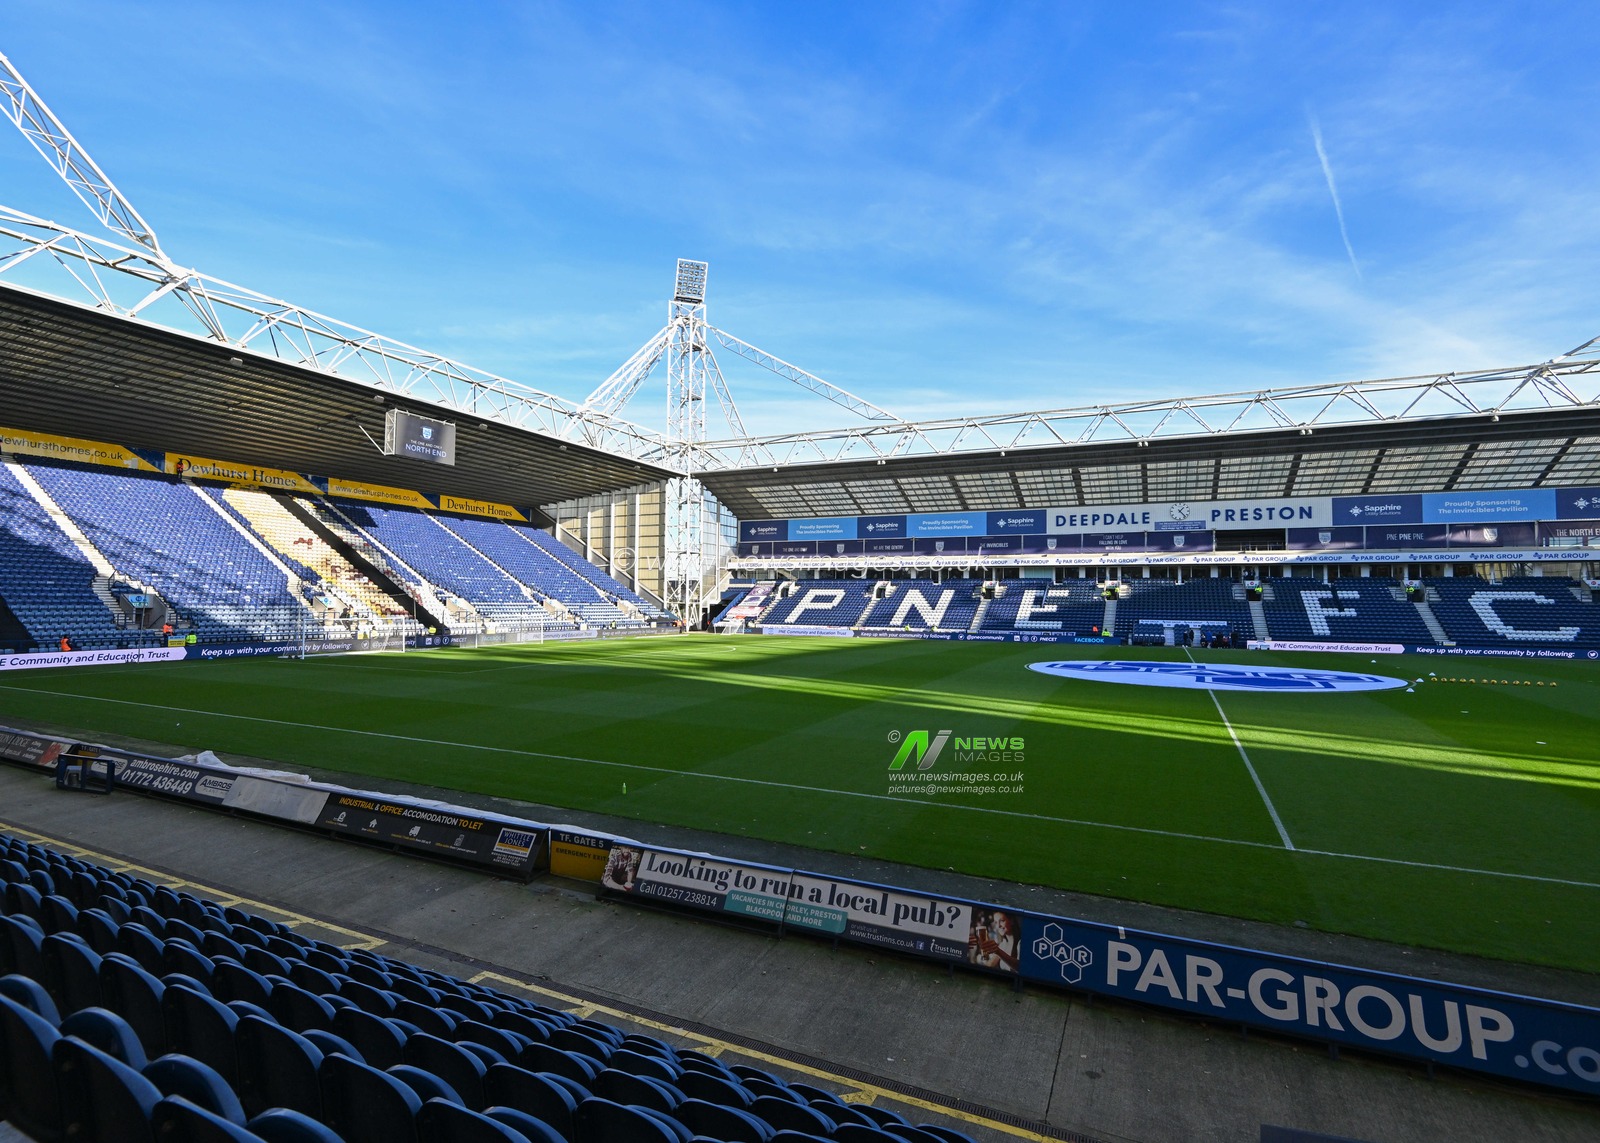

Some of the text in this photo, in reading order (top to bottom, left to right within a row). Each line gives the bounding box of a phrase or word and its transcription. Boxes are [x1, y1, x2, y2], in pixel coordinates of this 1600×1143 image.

[405, 443, 447, 458] NORTH END
[178, 458, 297, 488] Dewhurst Homes
[447, 498, 513, 519] Dewhurst Homes
[1364, 503, 1401, 514] Sapphire
[1452, 506, 1495, 514] Invincibles
[1496, 505, 1528, 513] Pavilion
[1475, 499, 1521, 507] Sponsoring
[1007, 516, 1034, 525] Sapphire
[1055, 512, 1150, 527] DEEPDALE
[1211, 505, 1313, 522] PRESTON
[875, 522, 899, 530] Sapphire
[941, 518, 969, 526] Sponsoring
[1386, 533, 1397, 541] PNE
[1569, 528, 1594, 537] NORTH
[10, 655, 73, 666] Community
[75, 652, 94, 663] and
[96, 651, 145, 662] Education
[147, 650, 170, 660] Trust
[201, 647, 223, 658] Keep
[223, 647, 235, 657] up
[236, 646, 253, 655] with
[254, 646, 272, 656] your
[273, 643, 310, 653] communty
[311, 643, 321, 653] by
[1416, 646, 1575, 658] Keep up with your community by following:
[130, 758, 200, 780] ambrosehire.com
[121, 769, 193, 795] 01772 436449
[339, 796, 483, 831] INDUSTRIAL & OFFICE ACCOMODATION TO LET
[503, 830, 532, 842] WHITTLE
[504, 837, 526, 847] JONES
[559, 833, 604, 848] TF. GATE 5
[556, 847, 592, 859] EMERGENCY
[638, 881, 719, 907] Call 01257 238814
[645, 853, 962, 929] Looking to run a local pub?
[731, 893, 767, 907] VACANCIES
[766, 900, 775, 908] IN
[810, 908, 843, 922] PRESTON
[745, 904, 823, 927] BLACKPOOL AND MORE
[849, 929, 915, 949] www.trustinns.co.uk
[934, 944, 949, 953] Trust
[949, 947, 963, 955] Inns
[1038, 942, 1088, 963] PAR
